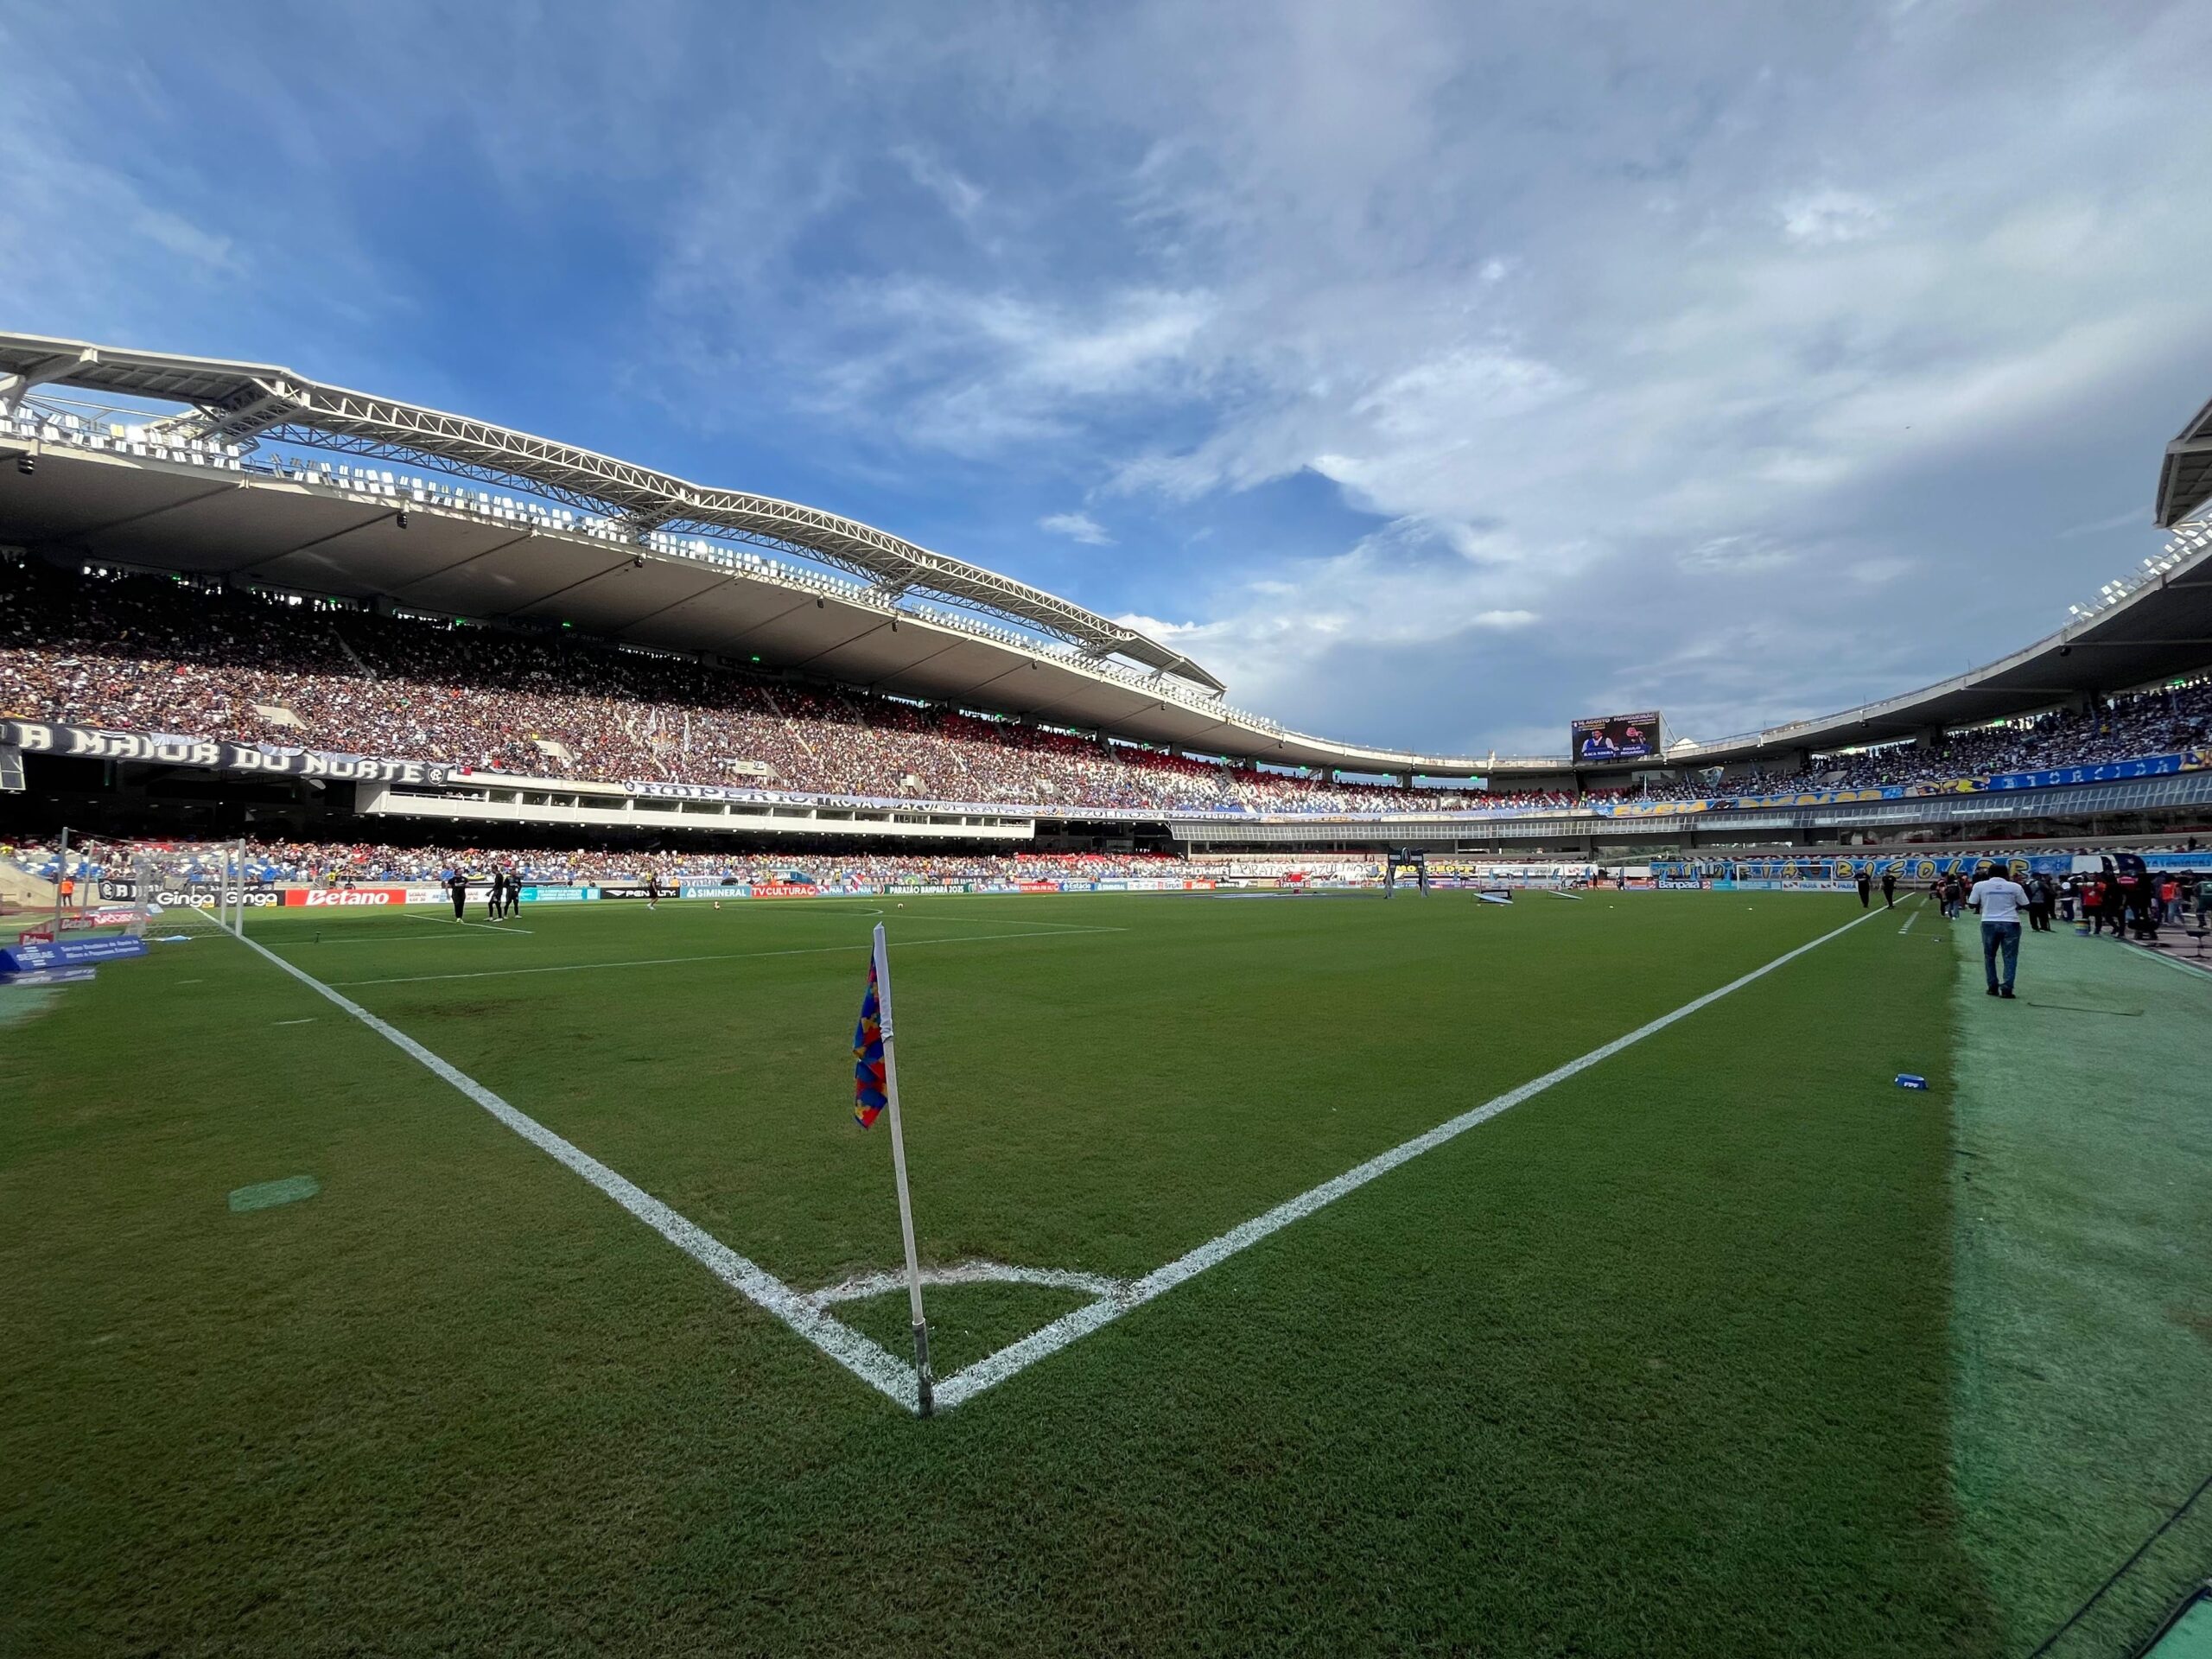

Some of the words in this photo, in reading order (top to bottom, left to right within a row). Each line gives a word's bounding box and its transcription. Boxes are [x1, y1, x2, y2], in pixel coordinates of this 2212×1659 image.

[17, 721, 54, 750] A
[66, 728, 221, 766] MAIOR
[229, 745, 290, 772] DO
[299, 754, 425, 784] NORTE
[1427, 865, 1475, 874] CHOPP
[949, 884, 964, 893] 2025
[1658, 880, 1700, 890] Banpará
[698, 888, 747, 897] SIMINERAL
[766, 887, 806, 896] CULTURA
[156, 891, 215, 906] Ginga
[226, 892, 277, 906] Gnga
[305, 889, 390, 905] Betano
